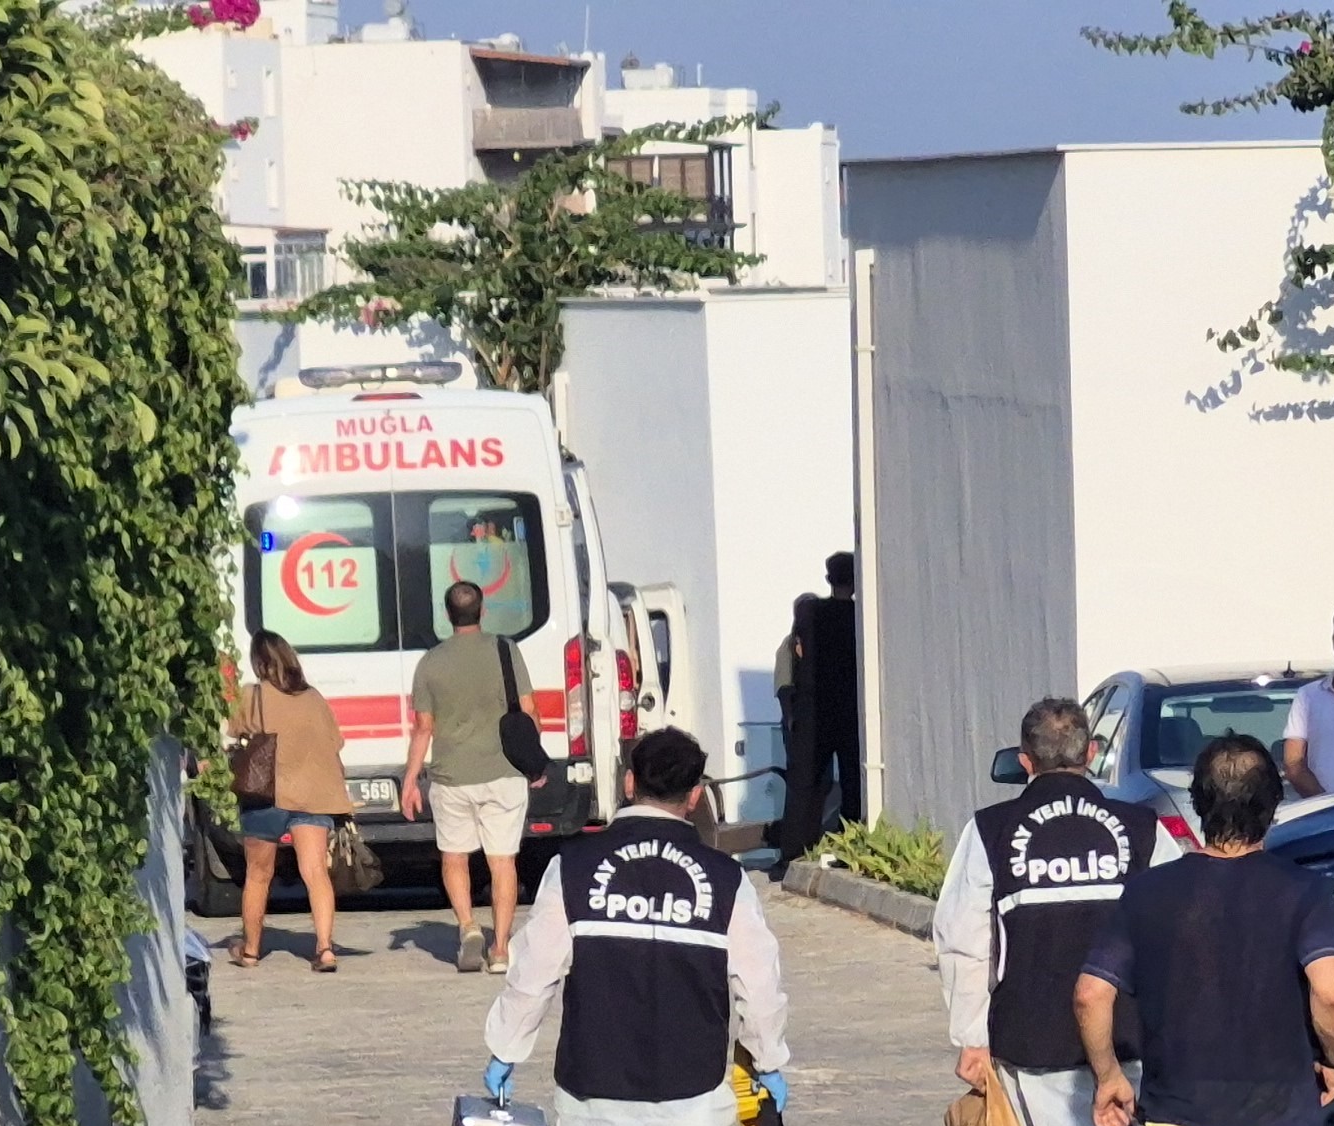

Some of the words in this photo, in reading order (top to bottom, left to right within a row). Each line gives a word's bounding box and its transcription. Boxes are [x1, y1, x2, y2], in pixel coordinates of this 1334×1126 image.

[336, 409, 433, 437] MUĞLA
[268, 438, 504, 476] AMBULANS
[302, 559, 358, 589] 112
[360, 782, 390, 800] 569
[1009, 823, 1033, 877] OLAY
[1028, 795, 1073, 825] YERİ
[588, 858, 616, 910] OLAY
[614, 839, 659, 862] YERİ
[1028, 849, 1119, 885] POLİS
[606, 892, 702, 924] POLİS
